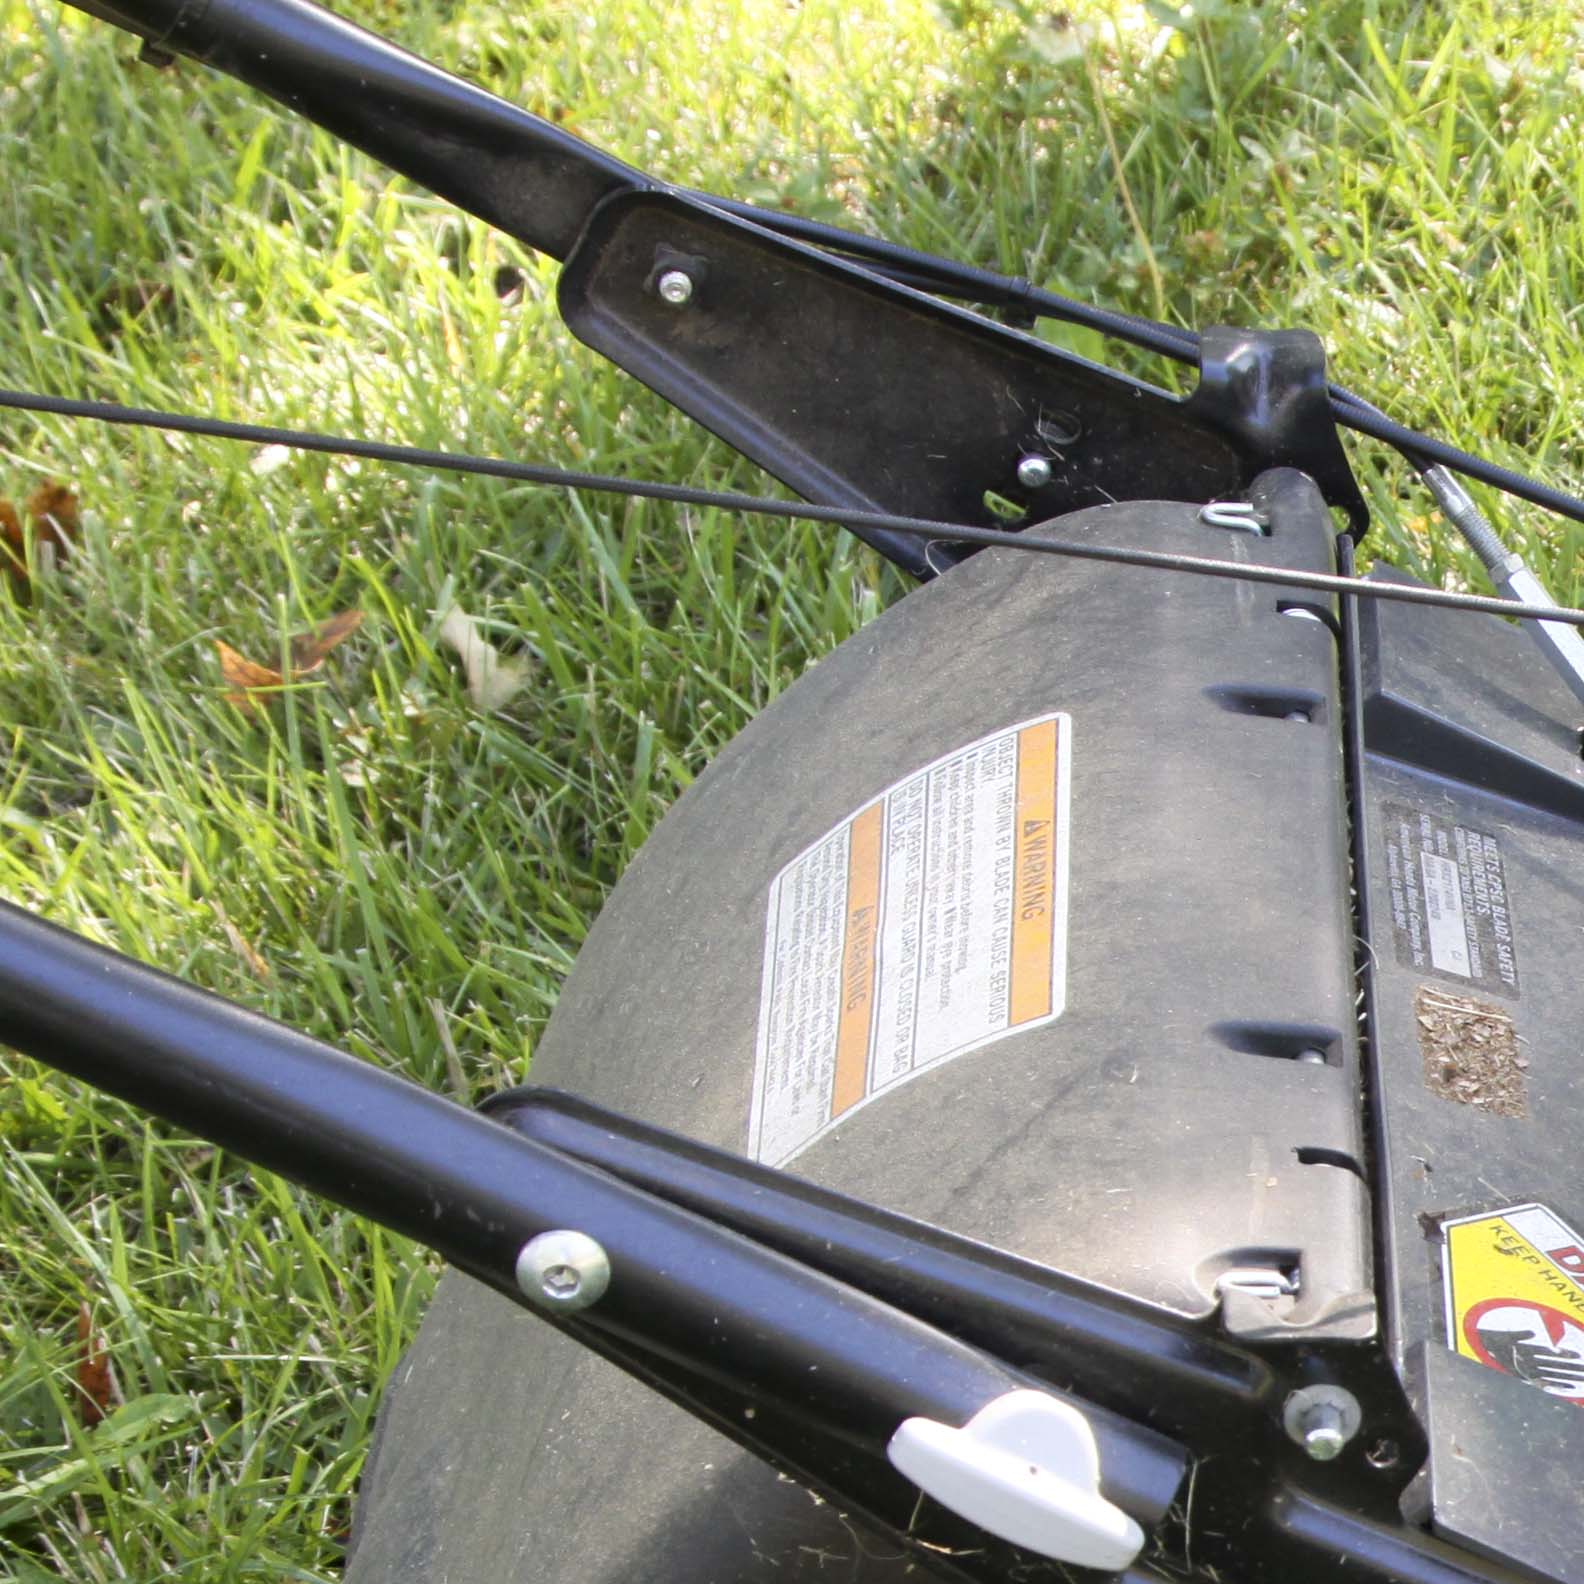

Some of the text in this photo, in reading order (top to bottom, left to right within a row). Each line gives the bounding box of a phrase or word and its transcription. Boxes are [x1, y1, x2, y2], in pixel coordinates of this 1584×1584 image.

[908, 799, 923, 820] NOT
[909, 779, 924, 798] DO
[906, 823, 922, 876] OPERATE
[988, 737, 1014, 1024] OBJECT THROWN BY BLADE CAN CAUSE SERIOUS
[1021, 835, 1048, 921] WARNING
[1483, 836, 1515, 986] MEETS CPSC BLADE SAFETY
[846, 921, 872, 1012] WARNING
[893, 1044, 910, 1073] BAG
[1489, 1223, 1540, 1267] KEEP
